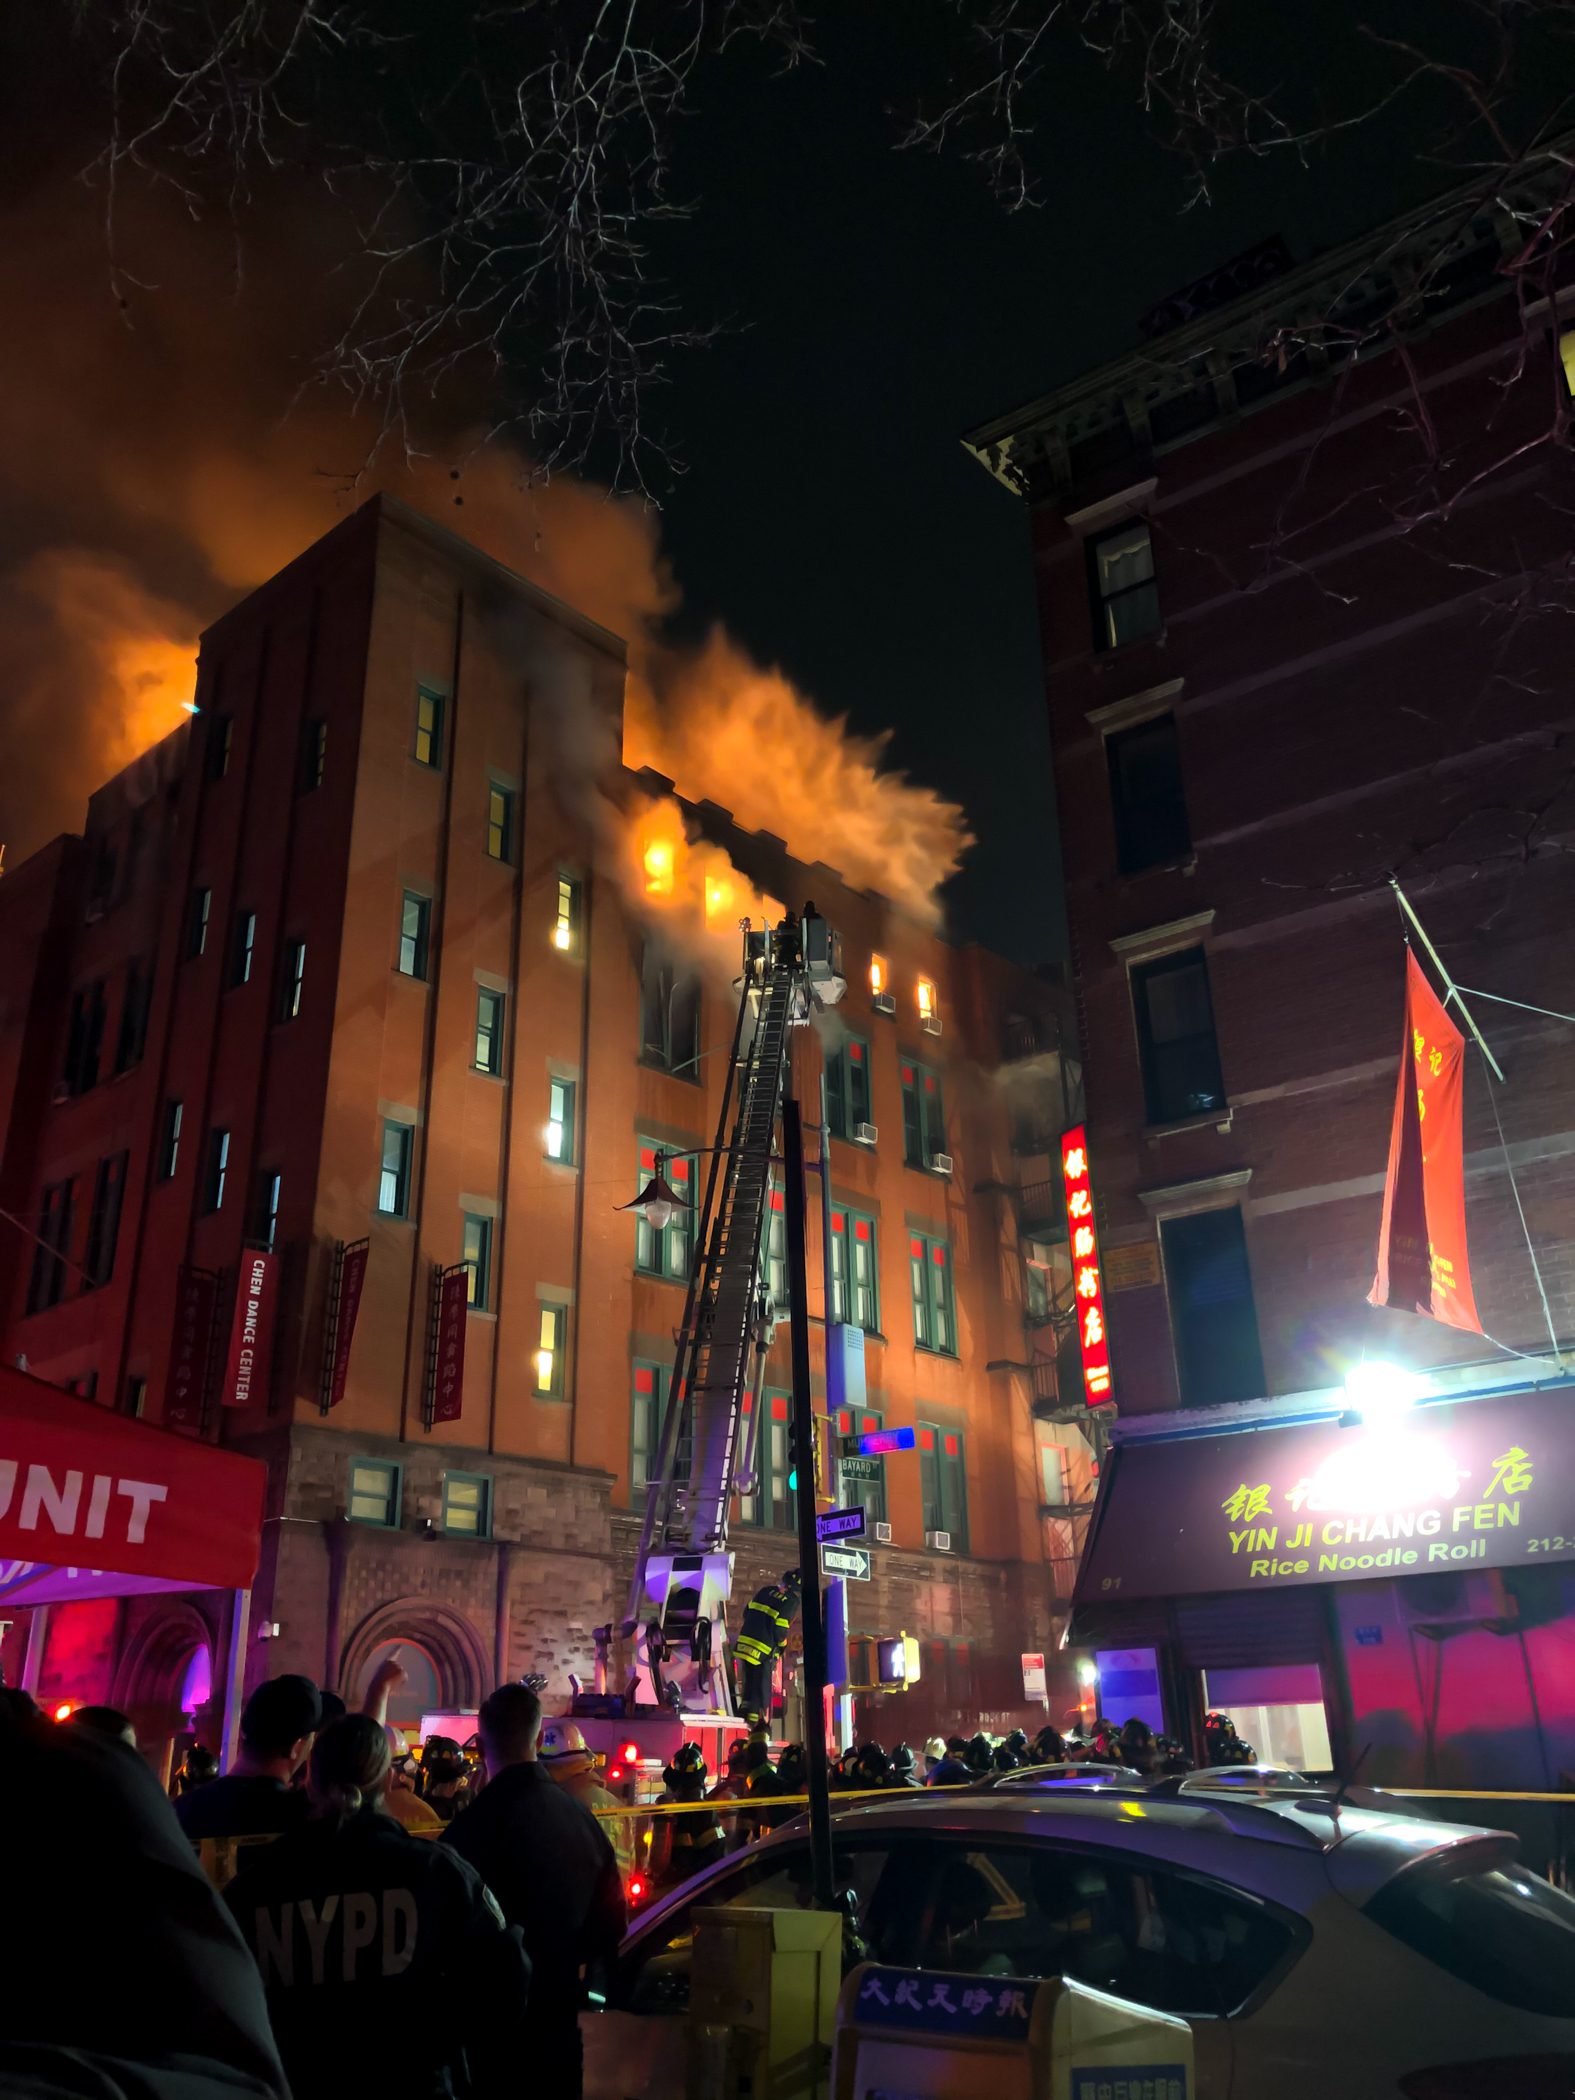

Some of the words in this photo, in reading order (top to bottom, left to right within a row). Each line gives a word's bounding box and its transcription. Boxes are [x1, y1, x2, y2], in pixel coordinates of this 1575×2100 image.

[251, 1259, 265, 1297] CHEN
[347, 1258, 360, 1294] CHEN
[243, 1300, 259, 1344] DANCE
[236, 1348, 253, 1401] CENTER
[847, 1431, 898, 1449] MULERRY
[842, 1459, 871, 1473] BAYARD
[838, 1517, 857, 1530] WAY
[1228, 1526, 1278, 1554] YIN
[1286, 1523, 1313, 1549] JI
[1321, 1509, 1440, 1546] CHANG
[1452, 1501, 1521, 1532] FEN
[829, 1554, 843, 1567] ONE
[849, 1557, 863, 1570] WAY
[1250, 1558, 1309, 1578] Rice
[1318, 1547, 1418, 1573] Noodle
[1428, 1538, 1487, 1562] Roll
[1527, 1536, 1575, 1553] 212-
[1101, 1576, 1122, 1591] 91
[254, 1886, 419, 1988] NYPD
